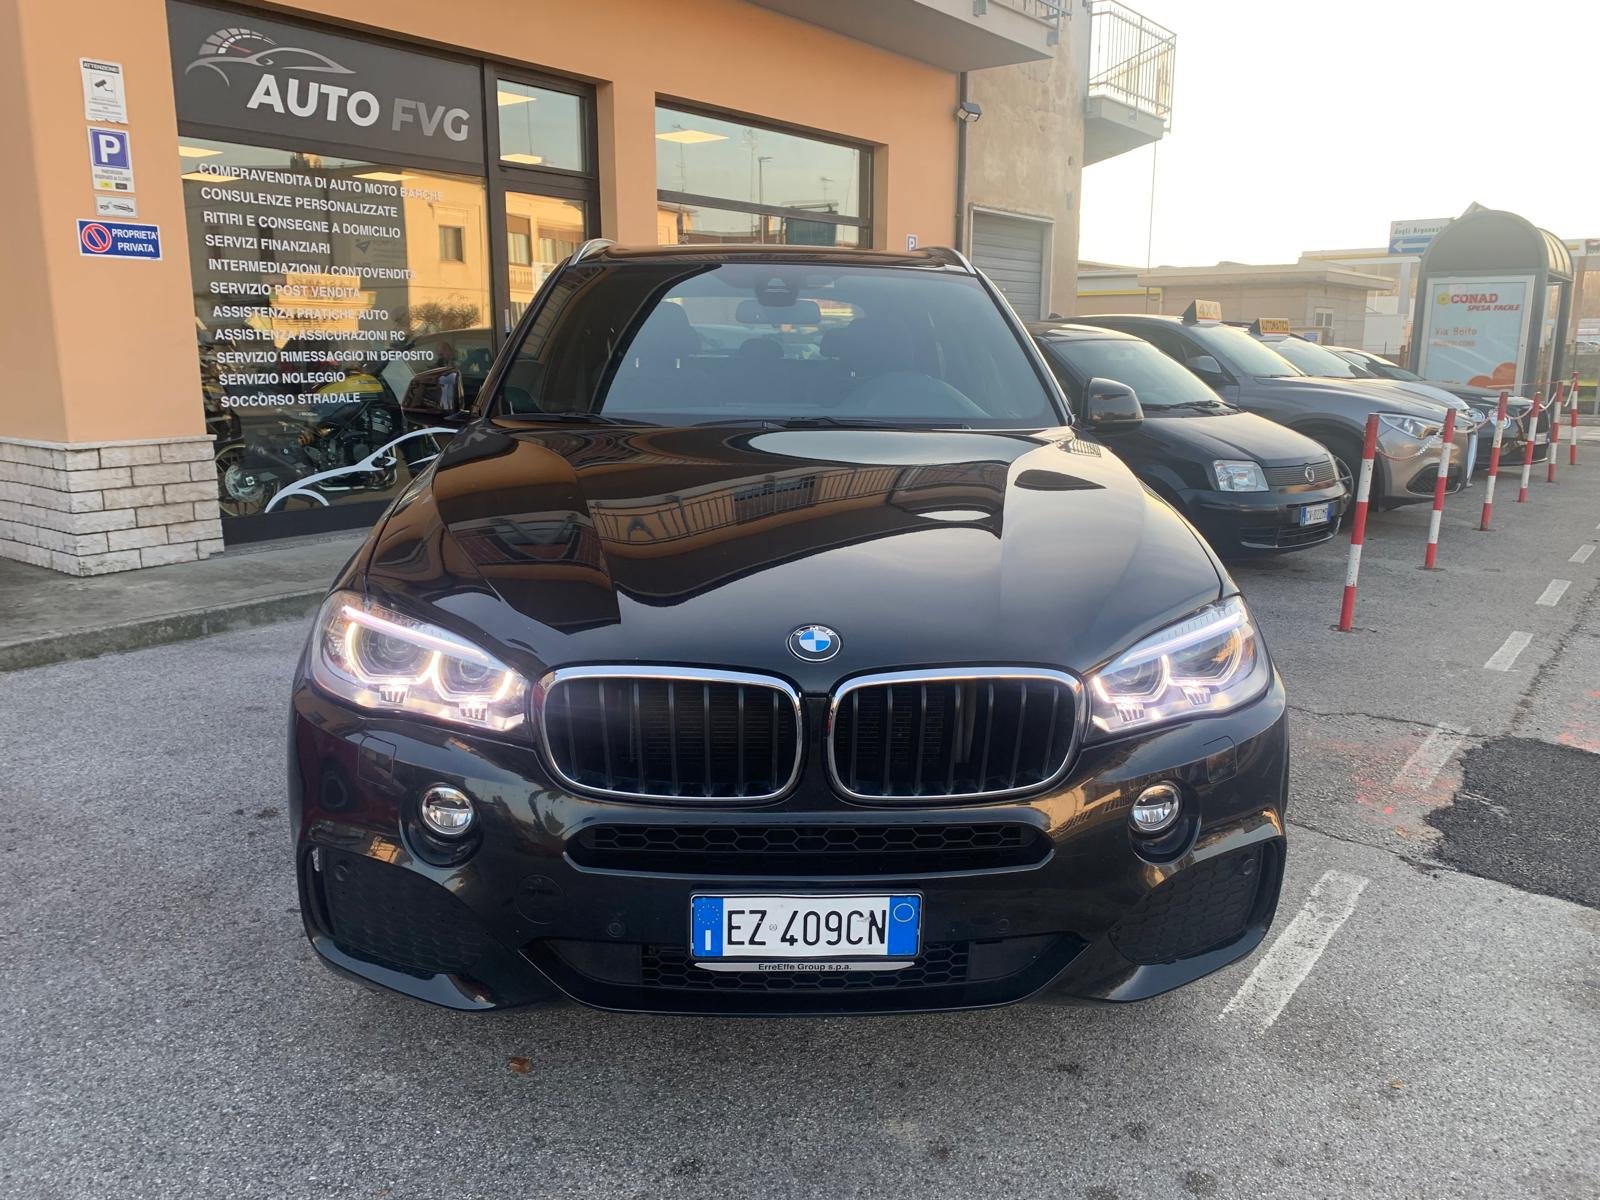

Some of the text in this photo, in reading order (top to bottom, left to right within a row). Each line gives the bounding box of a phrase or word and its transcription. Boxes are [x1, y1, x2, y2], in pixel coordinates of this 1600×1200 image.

[247, 74, 470, 142] AUTO FVG
[99, 134, 120, 163] P
[199, 163, 312, 188] COMPRAVENDITA
[315, 177, 327, 189] DI
[330, 179, 361, 192] AUTO
[365, 183, 397, 197] MOTO
[201, 187, 398, 217] CONSULENZE PERSONALIZZATE
[203, 210, 401, 239] RITIRI E CONSEGNE A DOMICILIO
[117, 242, 154, 253] PRIVATA
[205, 234, 331, 254] SERVIZI FINANZIARI
[909, 237, 915, 250] P
[208, 258, 321, 275] INTERMEDIAZIONI
[331, 265, 416, 280] CONTOVENDITA
[210, 281, 360, 298] SERVIZIO POST VENDITA
[1451, 293, 1498, 304] CONAD
[213, 305, 389, 321] ASSISTENZA PRATICHE AUTO
[1467, 304, 1491, 312] SPESA
[215, 328, 405, 341] ASSISTENZA ASSICURAZIONI RC
[1435, 327, 1448, 336] Via
[216, 350, 434, 363] SERVIZIO RIMESSAGGIO IN DEPOSITO
[219, 371, 346, 386] SERVIZIO NOLEGGIO
[220, 392, 361, 408] SOCCORSO STRADALE
[727, 910, 767, 946] EZ
[780, 910, 887, 946] 409CN
[758, 963, 851, 972] ErreEffe Group s.p.a.
